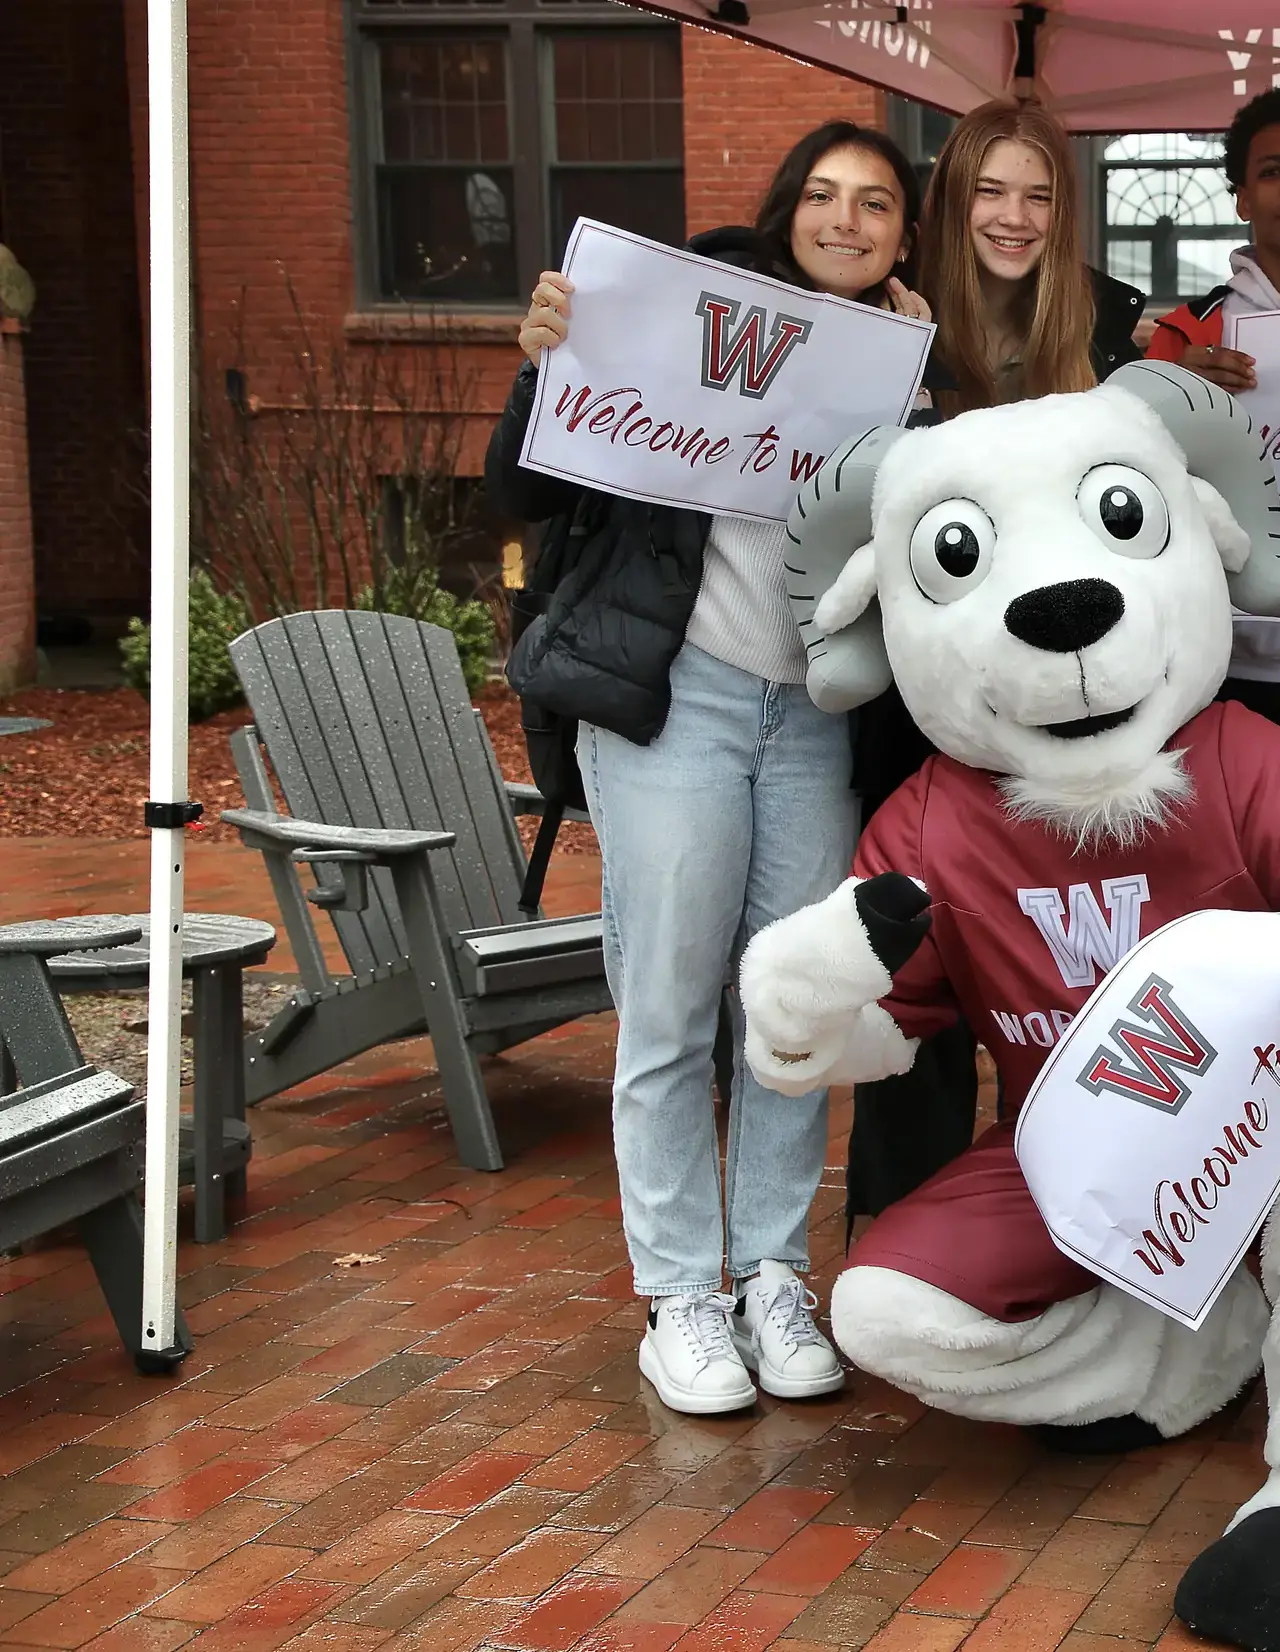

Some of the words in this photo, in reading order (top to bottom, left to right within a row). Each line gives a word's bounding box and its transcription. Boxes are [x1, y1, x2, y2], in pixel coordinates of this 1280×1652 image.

[695, 291, 813, 400] W
[554, 383, 734, 468] Welcome
[739, 424, 780, 474] to
[1017, 874, 1151, 988] W
[1076, 972, 1218, 1116] W
[1133, 1097, 1269, 1275] Welcome
